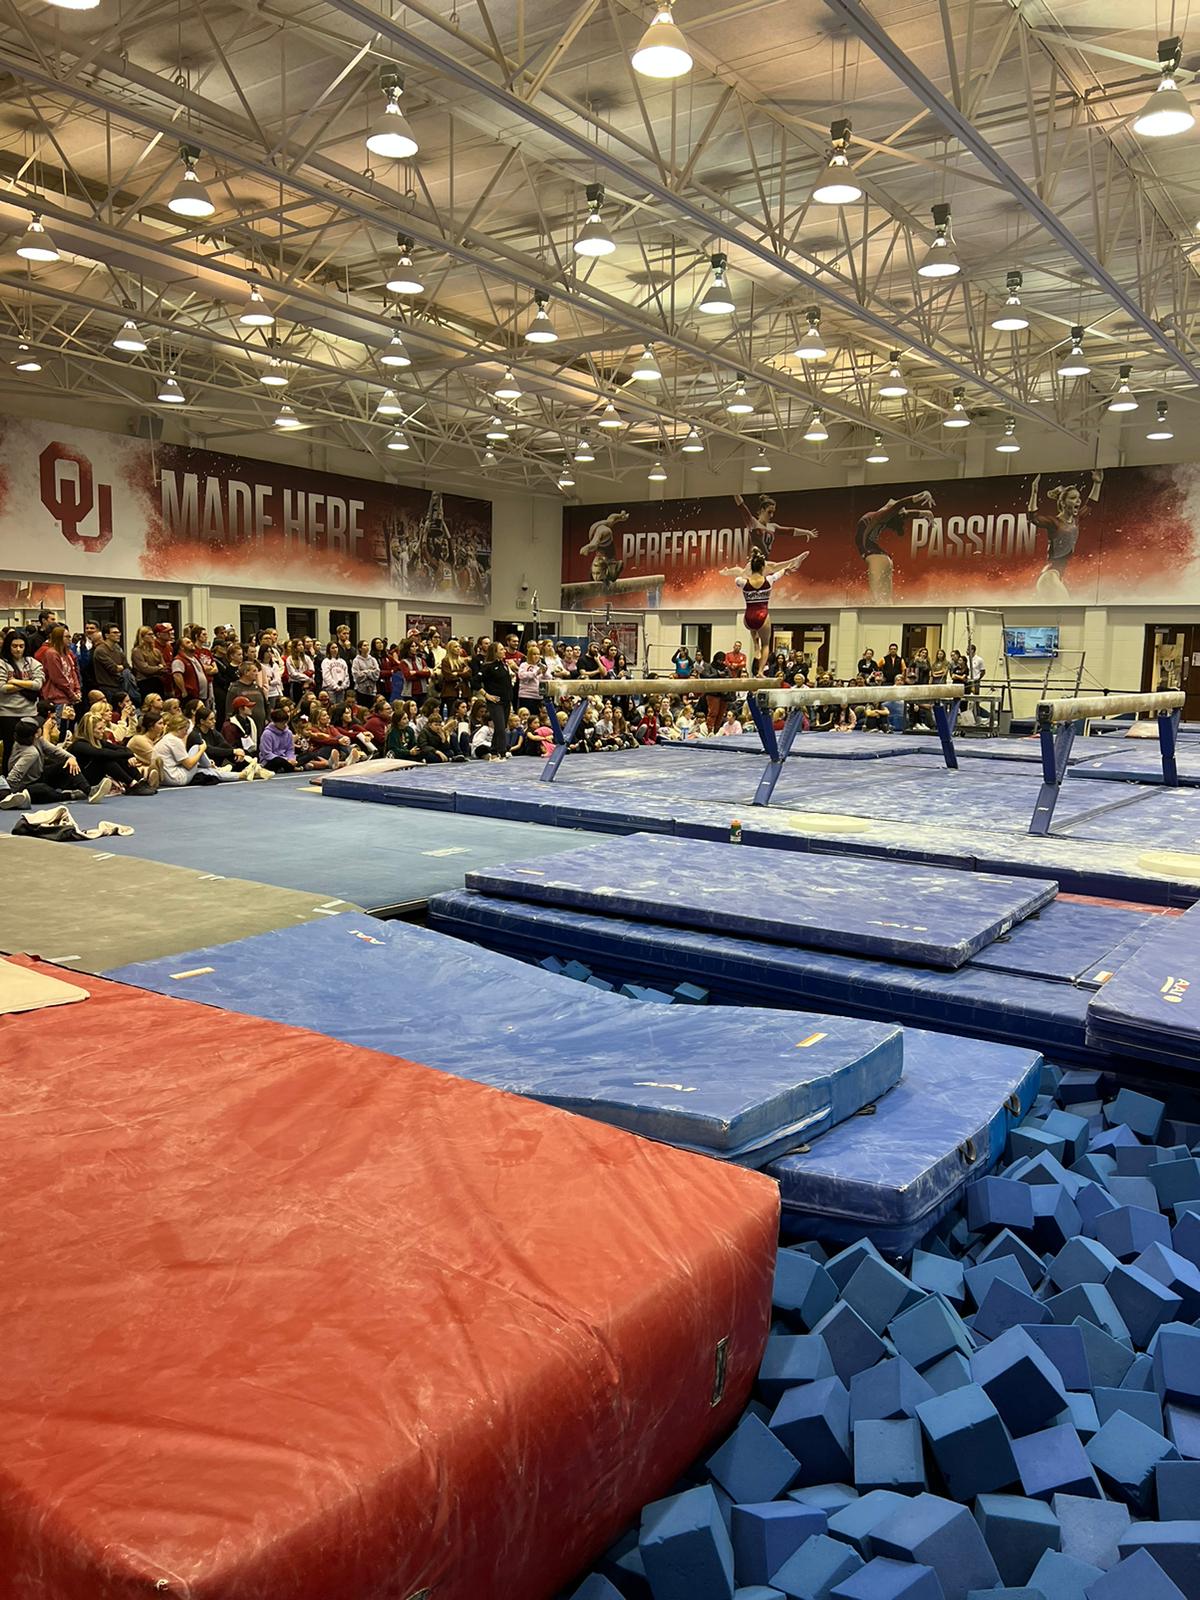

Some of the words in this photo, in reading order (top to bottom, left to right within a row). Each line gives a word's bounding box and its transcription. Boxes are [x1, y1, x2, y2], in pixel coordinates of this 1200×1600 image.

[39, 441, 112, 553] OU
[161, 469, 273, 547] MADE
[283, 488, 365, 557] HERE
[622, 527, 750, 567] PERFECTION
[911, 513, 1037, 559] PASSION
